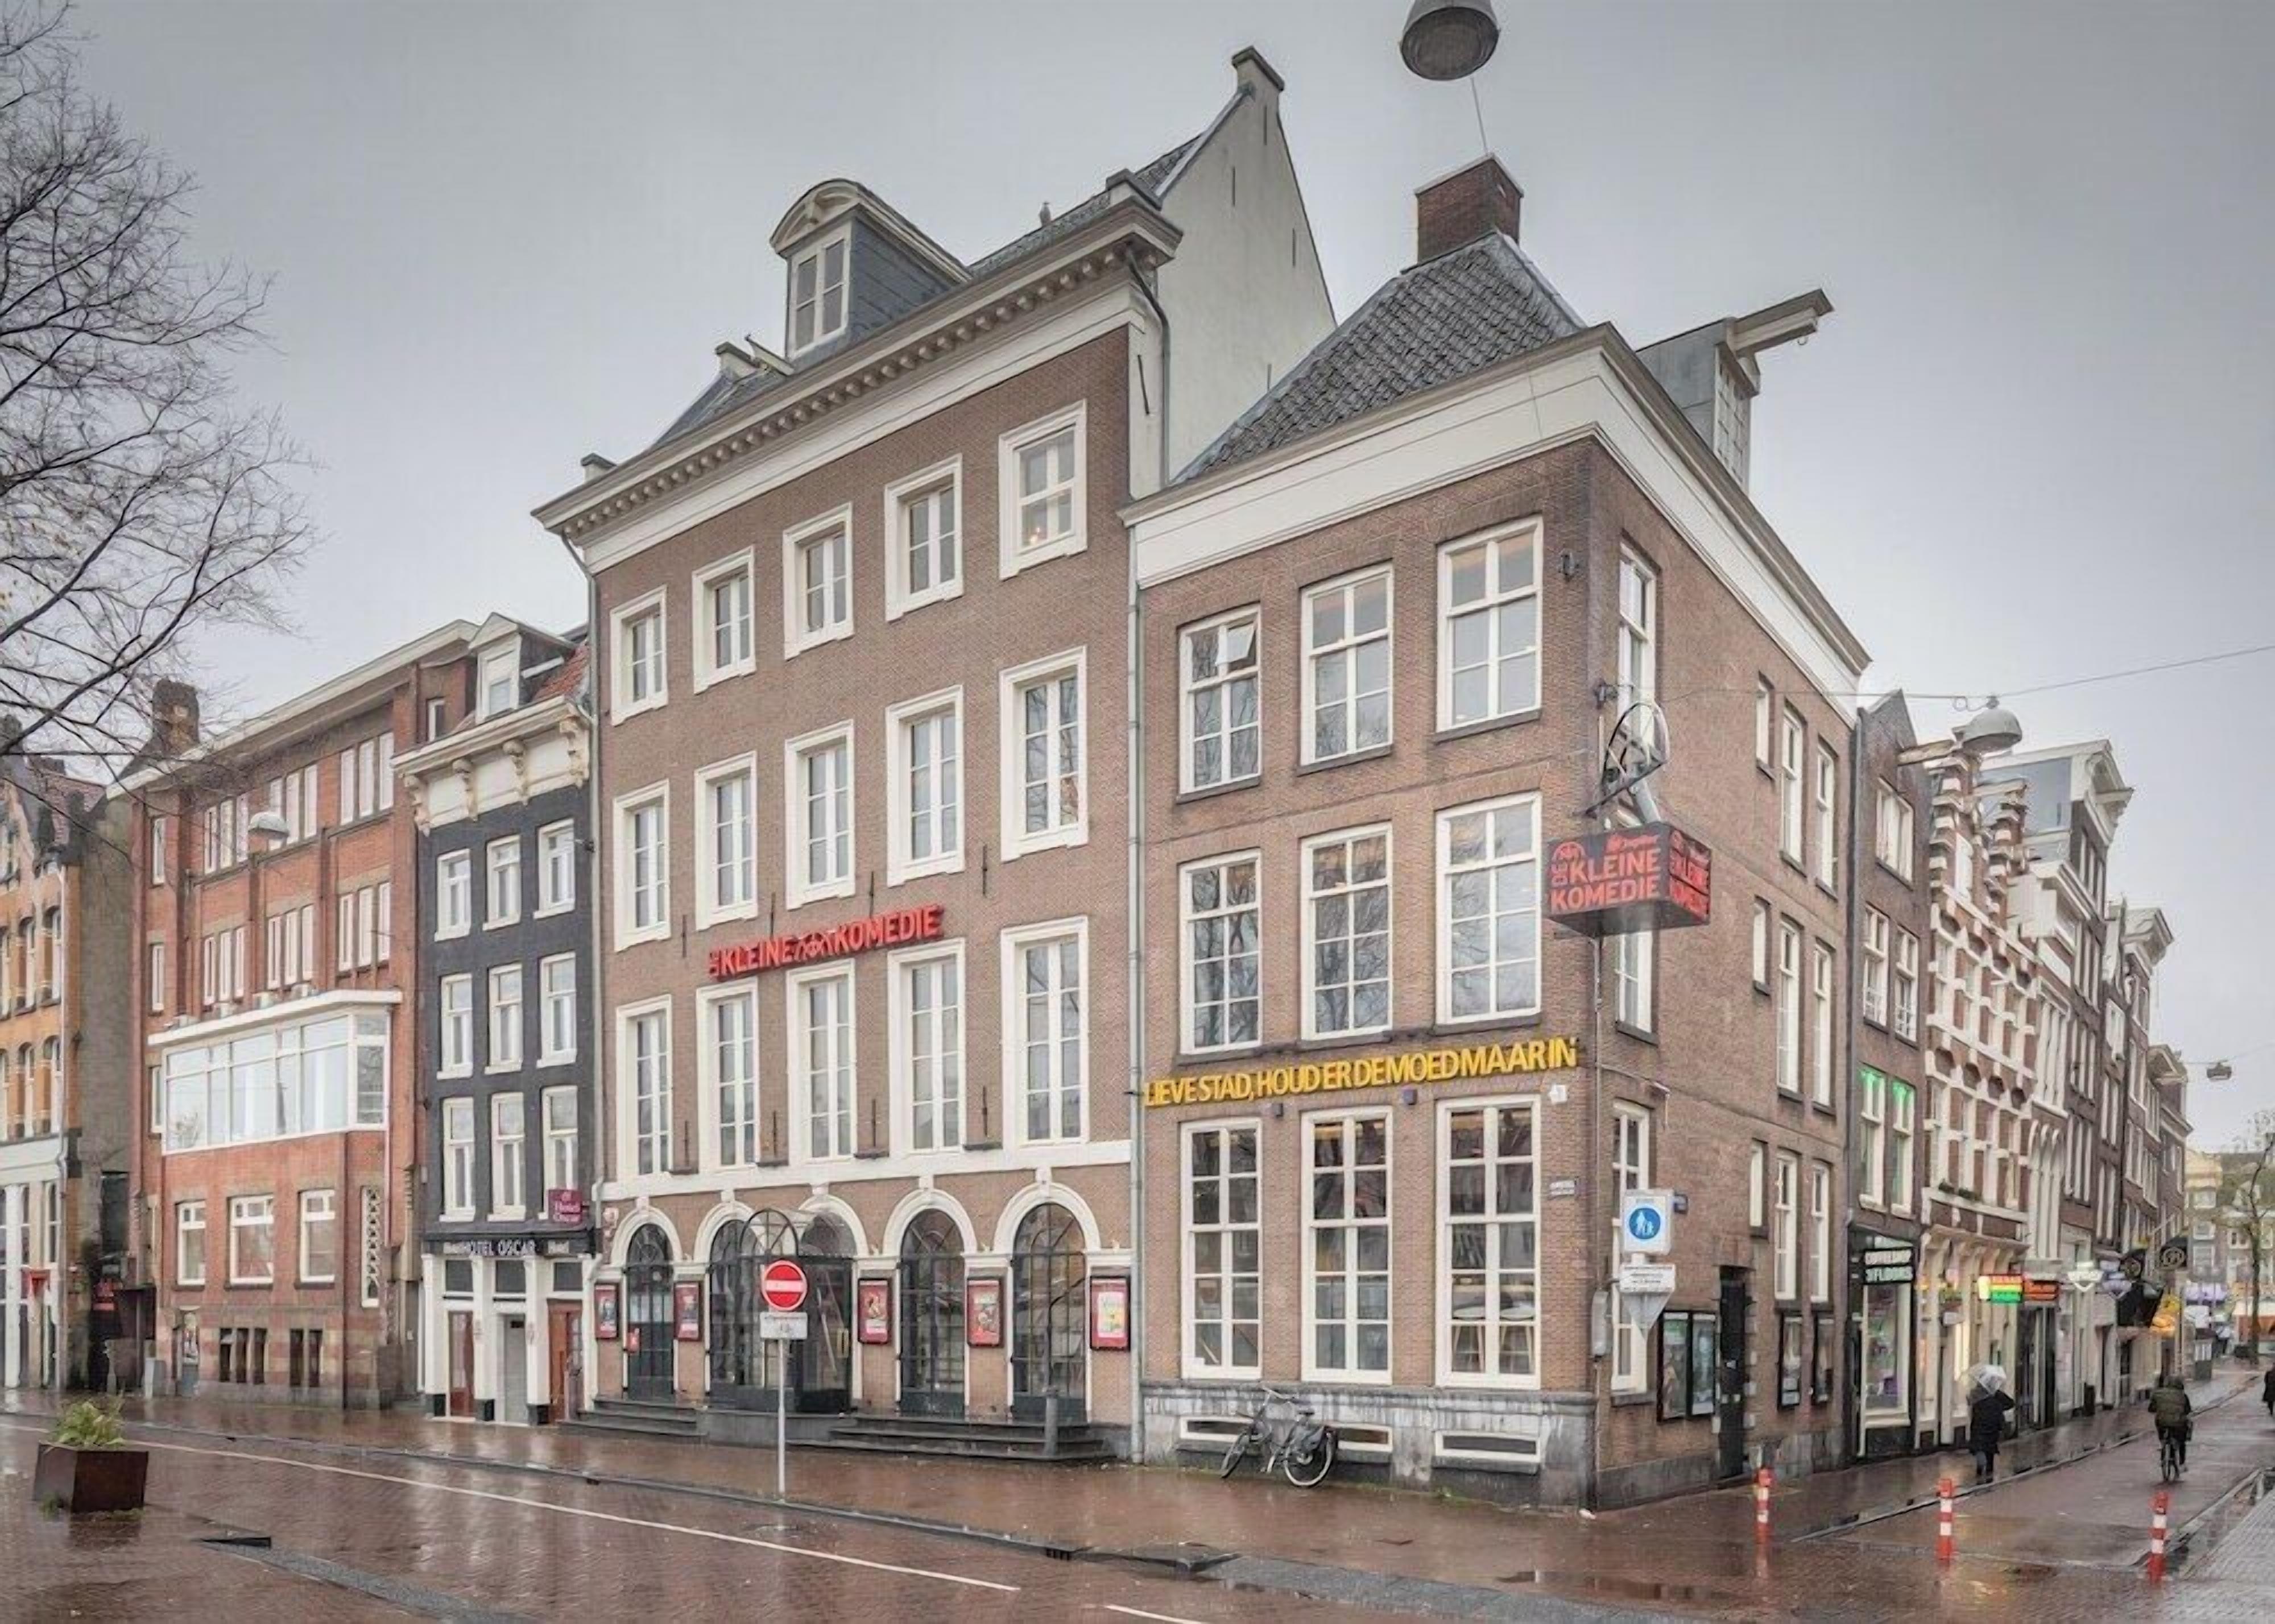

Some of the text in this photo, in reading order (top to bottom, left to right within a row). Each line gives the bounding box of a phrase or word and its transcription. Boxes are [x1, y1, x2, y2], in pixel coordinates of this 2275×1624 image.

[1568, 847, 1661, 884] KLEINE
[1550, 876, 1660, 914] KOMEDIE
[721, 937, 795, 976] KLEINE
[835, 904, 941, 955] KOMEDIE
